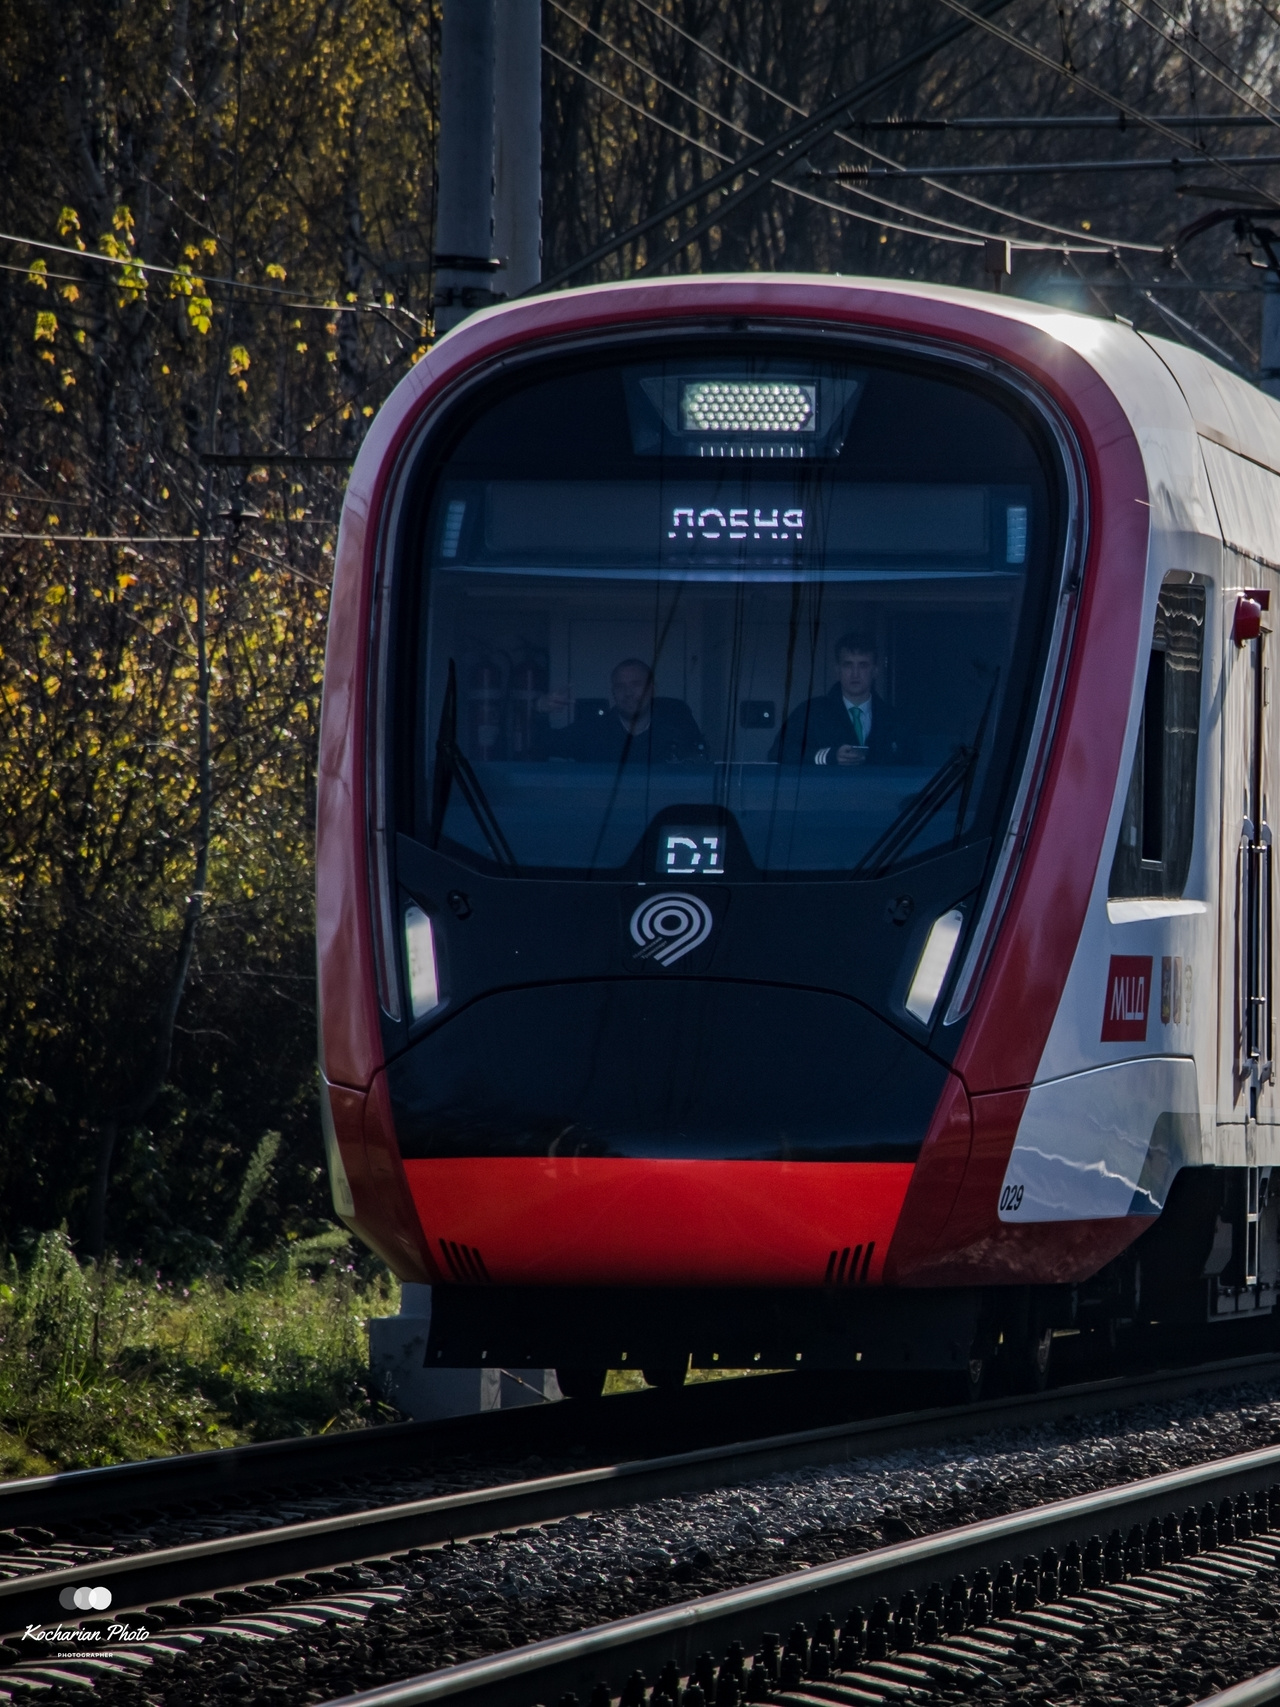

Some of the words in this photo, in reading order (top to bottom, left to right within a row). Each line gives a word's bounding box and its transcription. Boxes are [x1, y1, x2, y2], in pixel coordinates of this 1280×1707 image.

[668, 508, 803, 539] ЛОБНЯ
[666, 837, 724, 873] D1
[1000, 1185, 1024, 1211] 029
